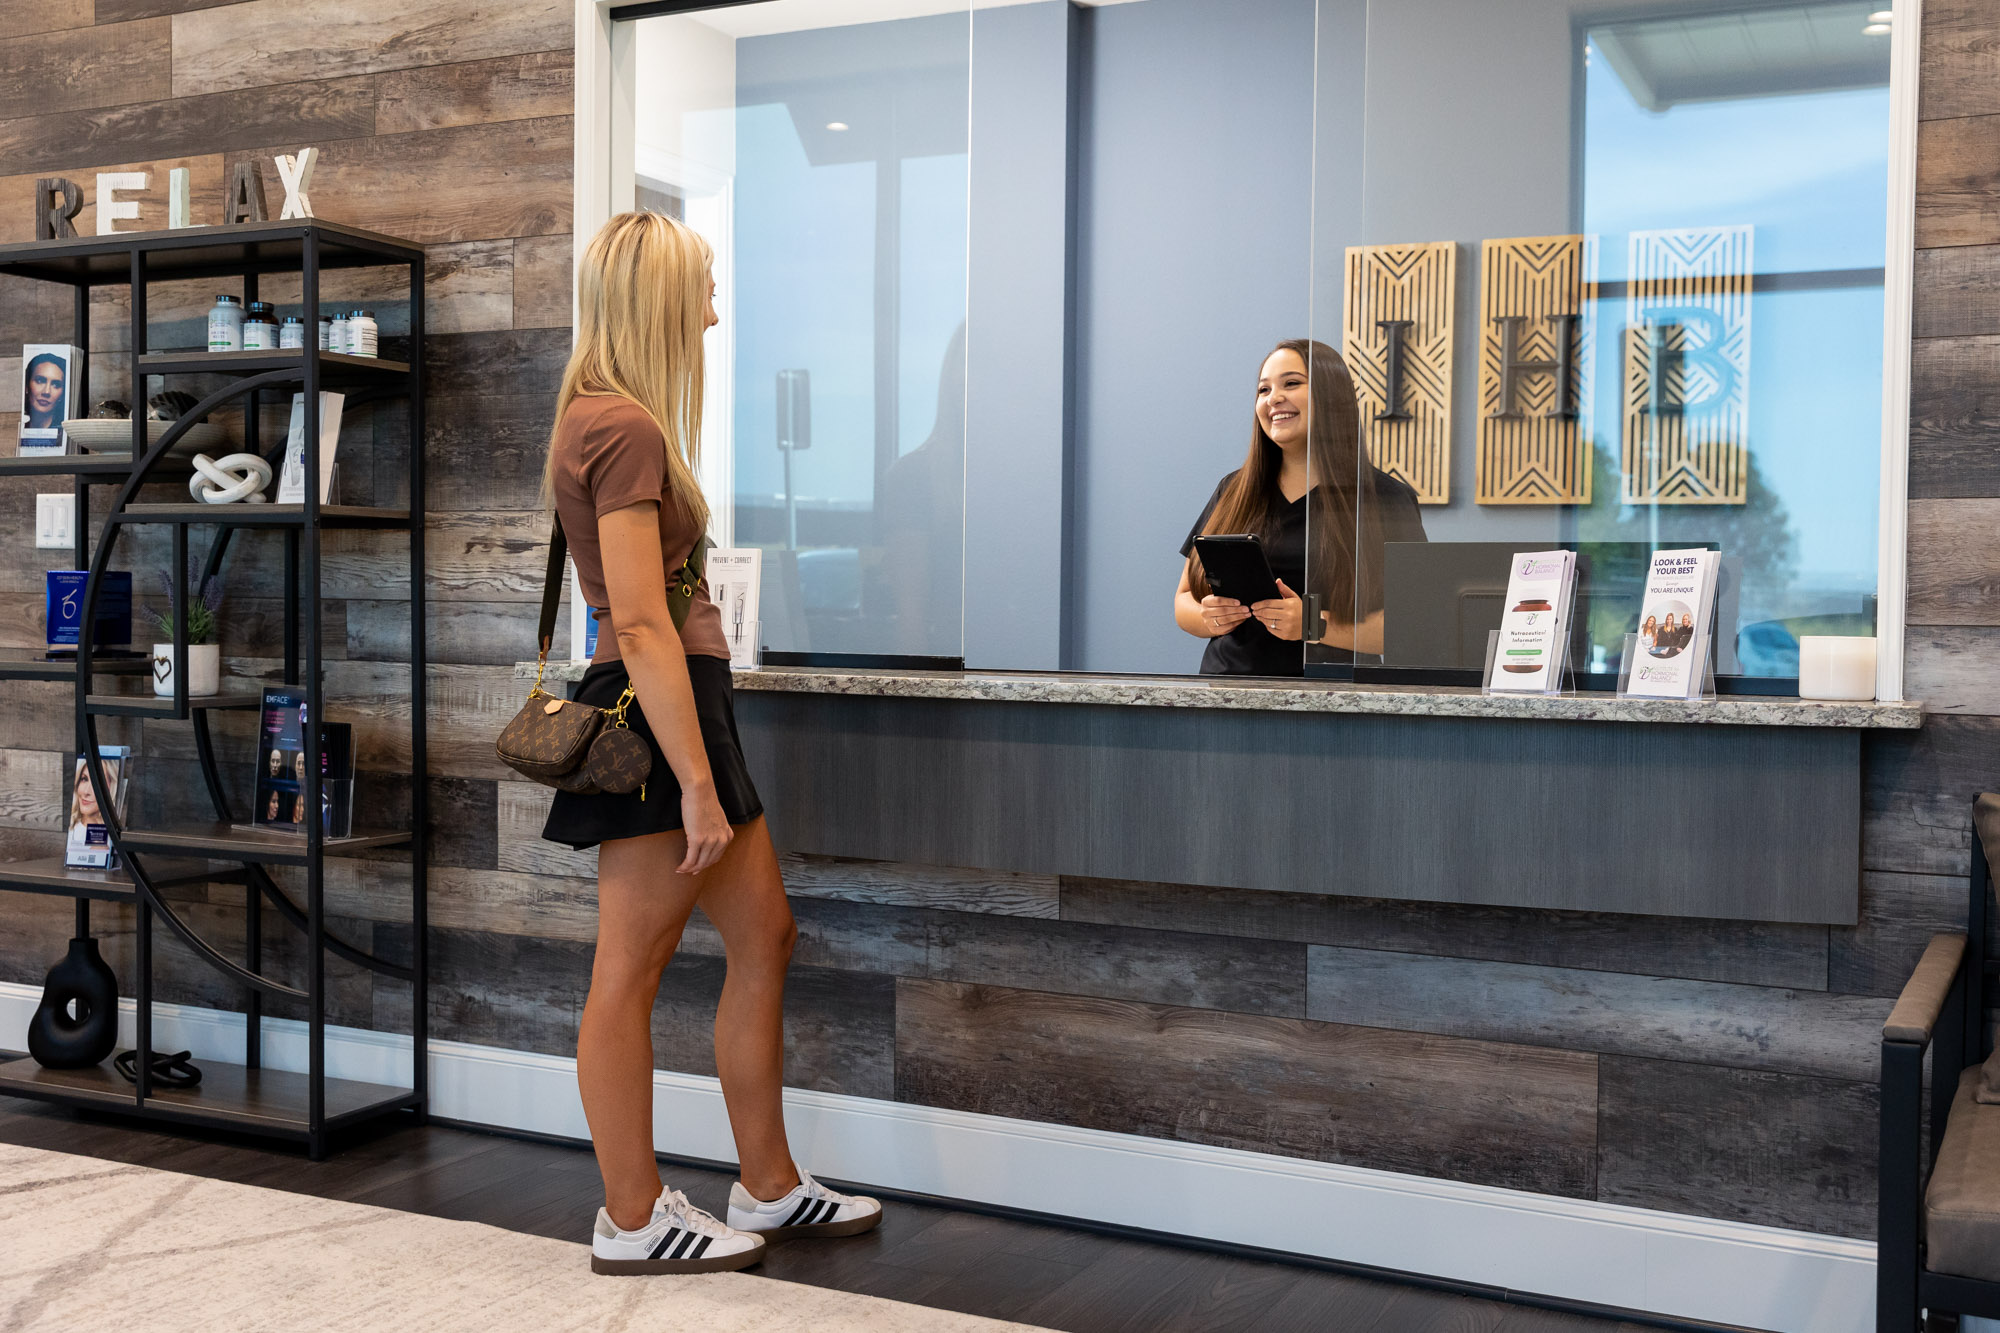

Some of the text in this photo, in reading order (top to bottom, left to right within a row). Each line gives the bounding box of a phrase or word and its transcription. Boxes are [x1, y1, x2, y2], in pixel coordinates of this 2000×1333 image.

[35, 147, 319, 241] RELAX
[712, 556, 729, 564] PREVENT
[734, 556, 752, 564] CORRECT
[1676, 558, 1682, 566] &
[1683, 557, 1698, 565] FEEL
[1656, 566, 1695, 575] YOUR BEST
[1673, 586, 1694, 594] UNIQUE
[266, 695, 289, 704] EMFACE
